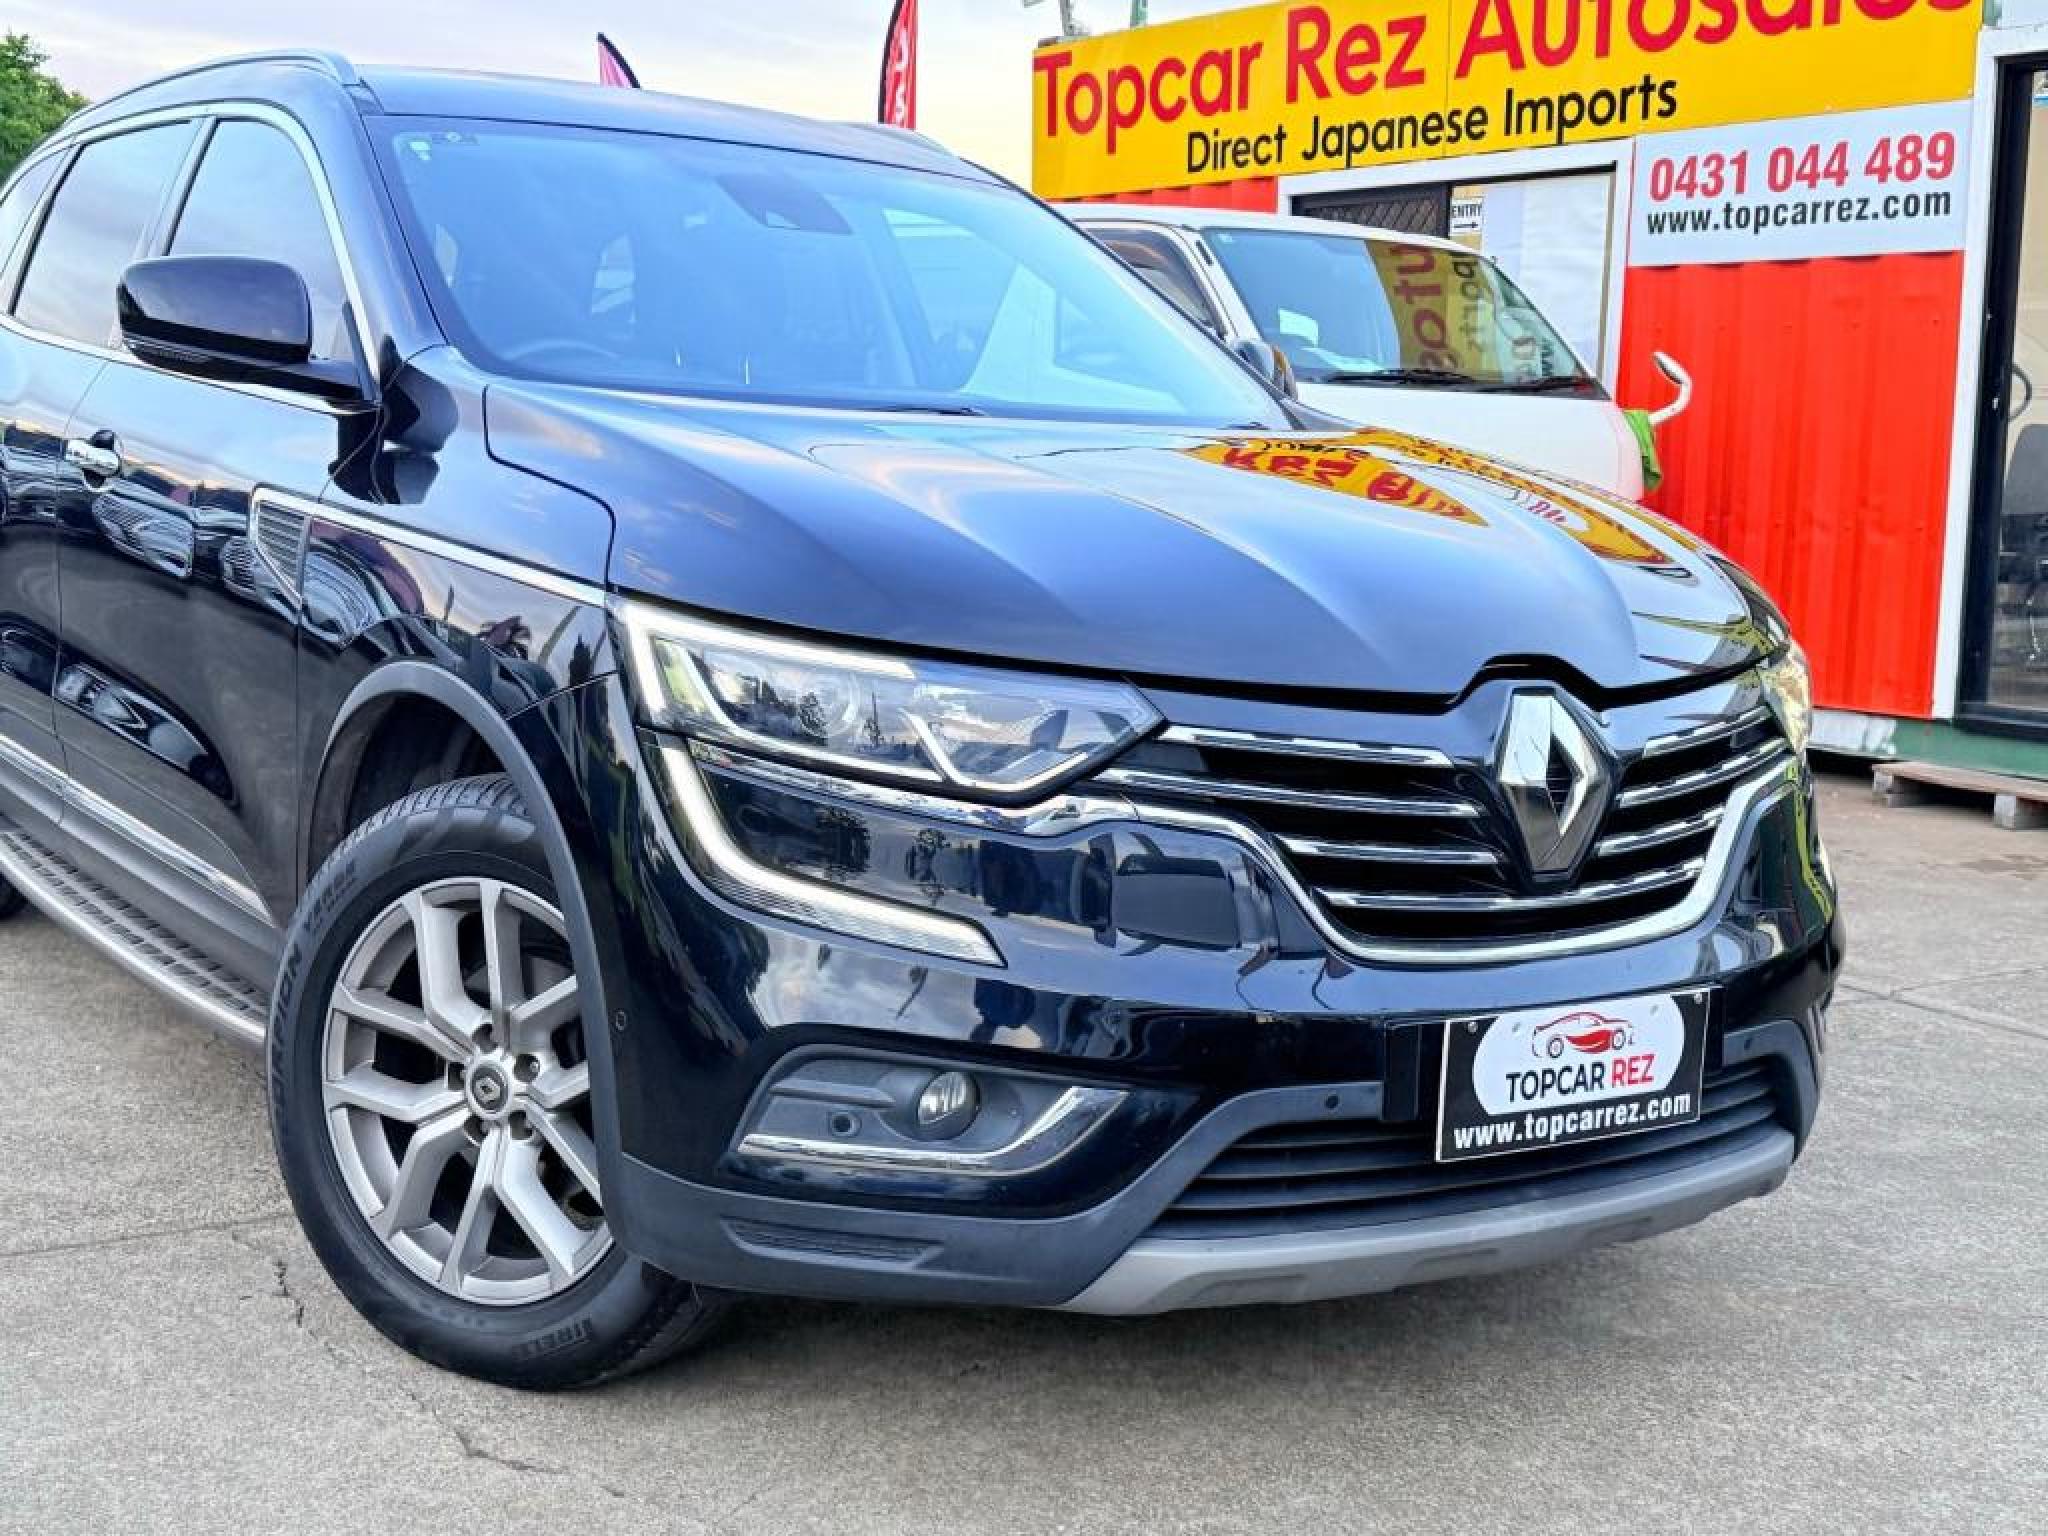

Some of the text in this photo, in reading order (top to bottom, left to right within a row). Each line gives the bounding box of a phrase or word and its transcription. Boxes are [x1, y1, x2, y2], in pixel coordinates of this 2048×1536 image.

[1033, 0, 1970, 154] Topcar Rez Autosa
[1187, 73, 1677, 174] Direct Japanese Imports
[1650, 131, 1956, 202] 0431 044 489
[1450, 203, 1483, 218] ENTRY
[1646, 191, 1952, 235] www.topcarrez.com
[1505, 1054, 1655, 1103] TOPCAR REZ
[1453, 1093, 1691, 1149] www.topcarrez.com
